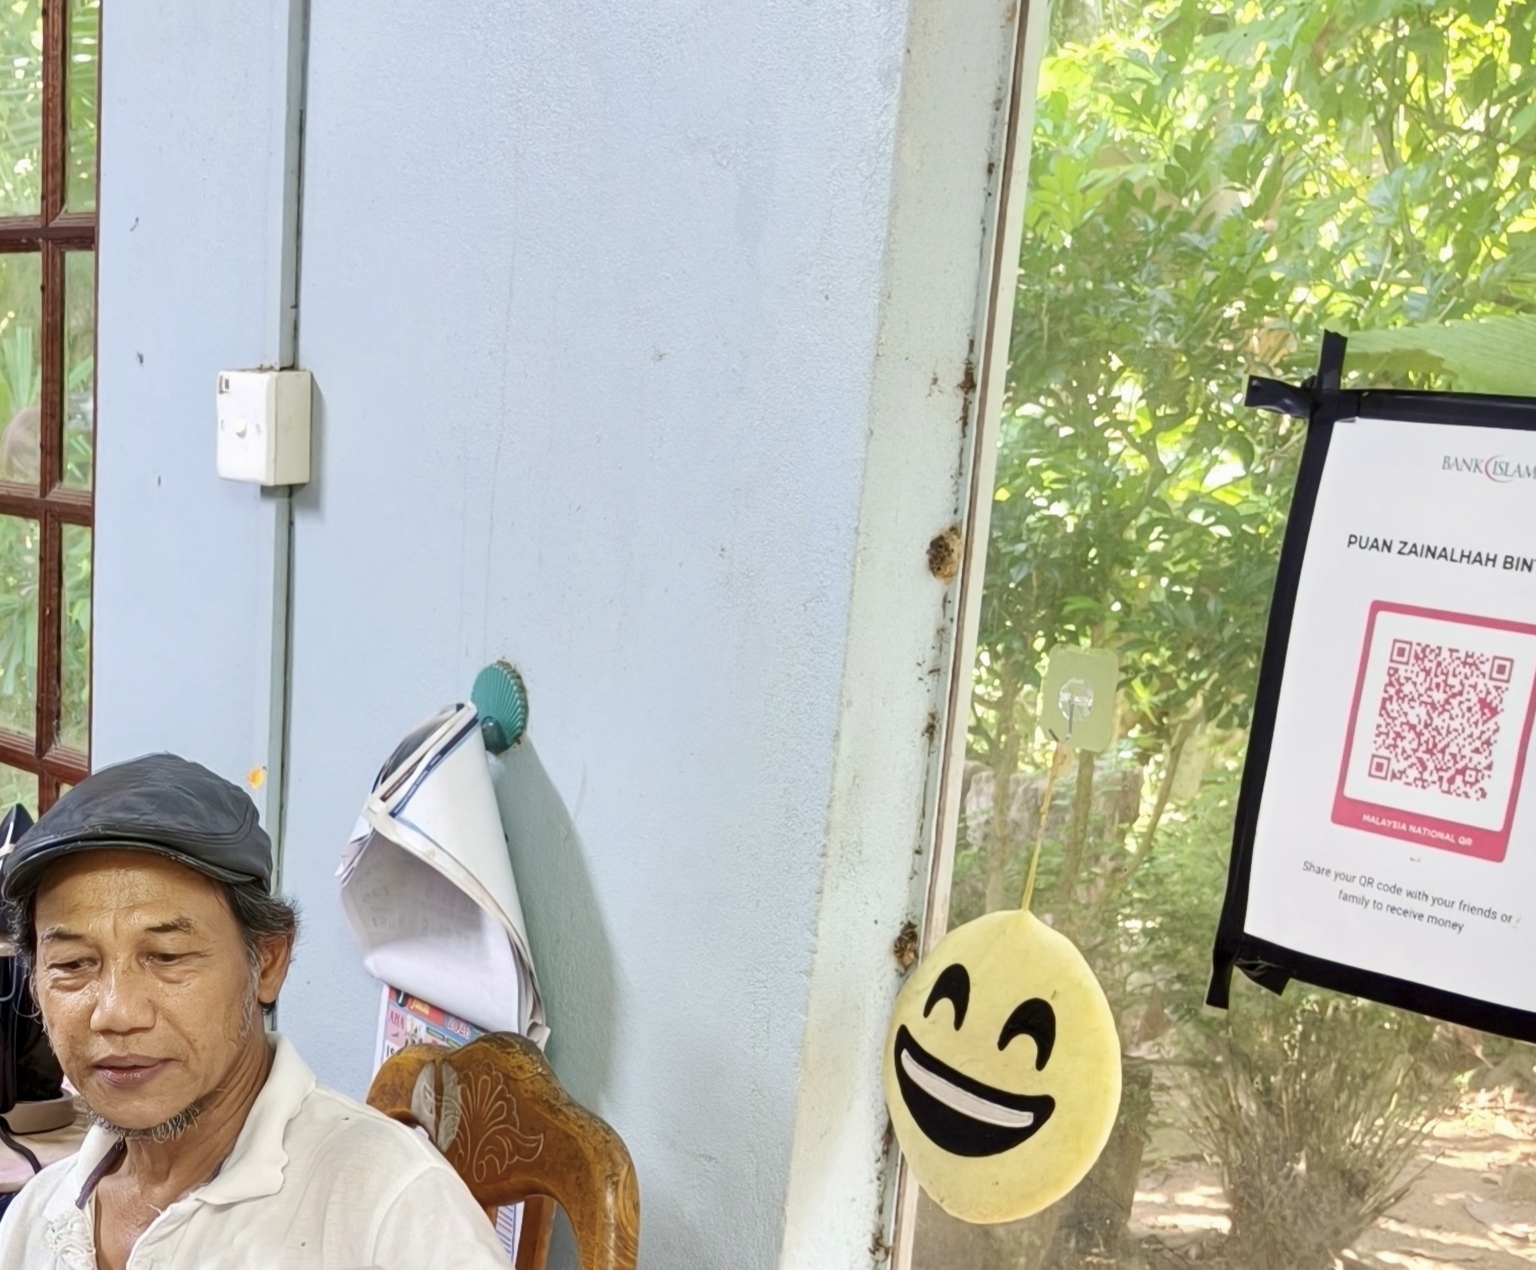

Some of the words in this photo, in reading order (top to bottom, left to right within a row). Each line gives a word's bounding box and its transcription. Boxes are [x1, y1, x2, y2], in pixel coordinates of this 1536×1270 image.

[1441, 455, 1483, 474] BANK
[1347, 534, 1393, 553] PUAN
[1397, 540, 1497, 568] ZAINALHAH
[1502, 555, 1536, 573] BIN
[1362, 813, 1407, 832] MALAYSIA
[1409, 824, 1455, 844] NATIONAL
[1458, 836, 1473, 847] QR
[1302, 860, 1331, 878] Share
[1333, 870, 1356, 884] your
[1359, 875, 1375, 888] QR
[1376, 881, 1403, 896] code
[1405, 888, 1429, 902] with
[1431, 895, 1455, 911] your
[1458, 901, 1498, 921] friends
[1500, 914, 1513, 924] or
[1338, 889, 1370, 910] family
[1372, 900, 1383, 911] to
[1385, 905, 1424, 922] receive
[1426, 913, 1465, 934] money
